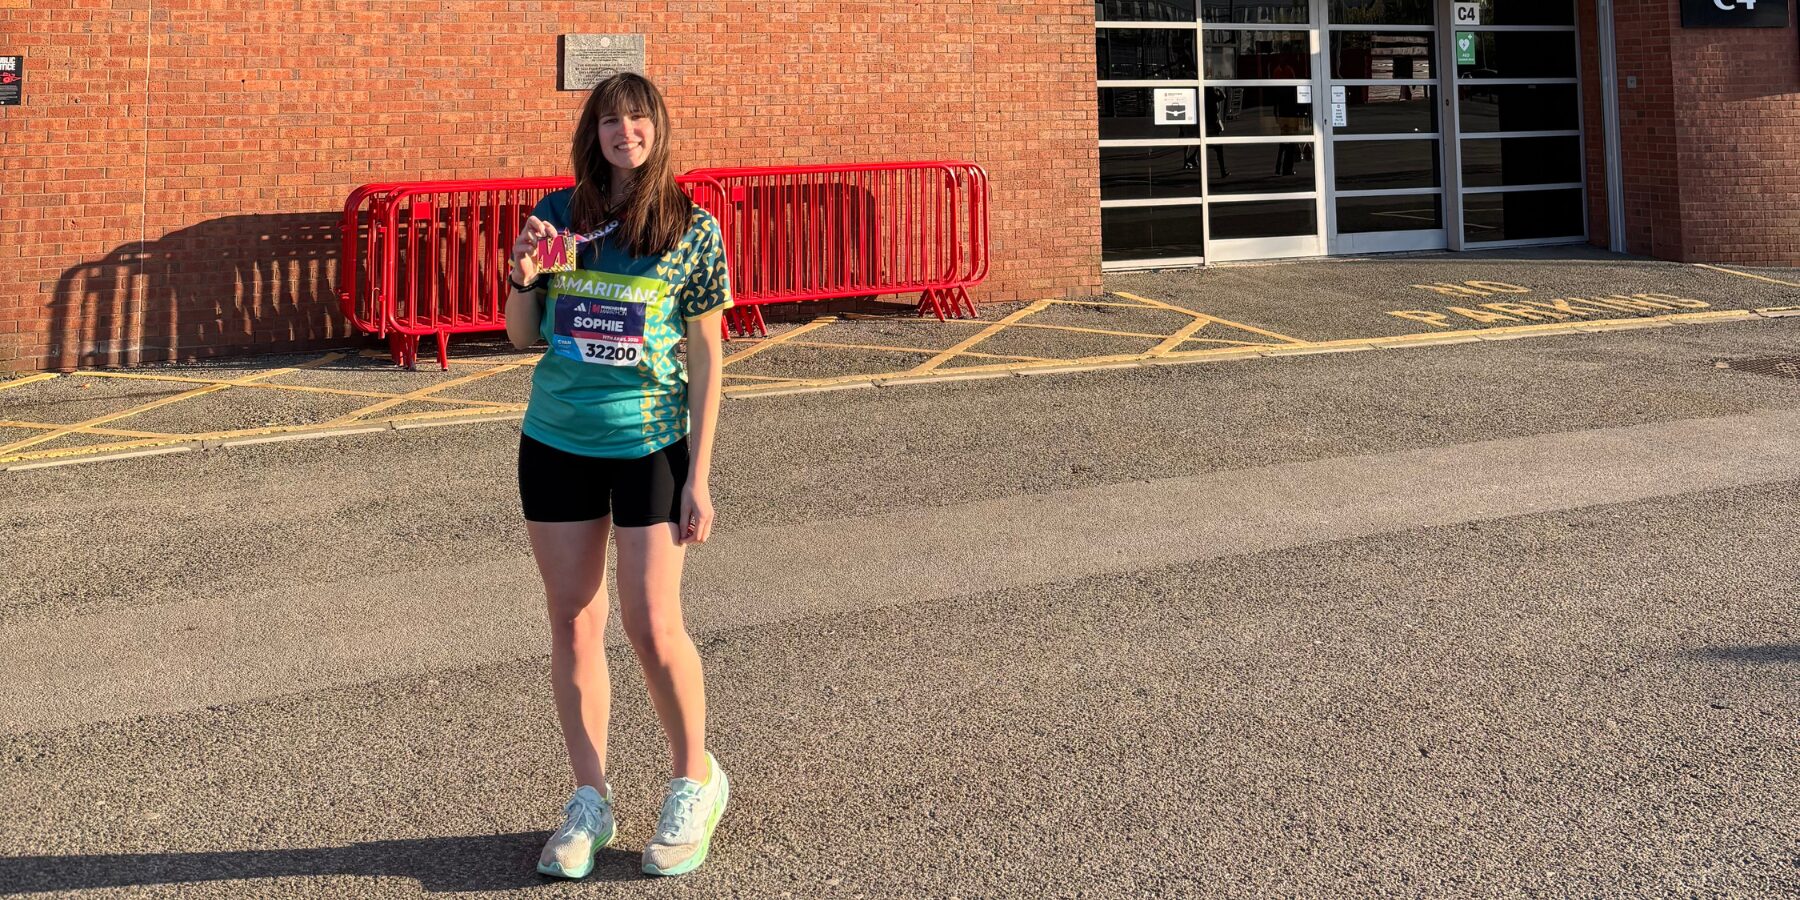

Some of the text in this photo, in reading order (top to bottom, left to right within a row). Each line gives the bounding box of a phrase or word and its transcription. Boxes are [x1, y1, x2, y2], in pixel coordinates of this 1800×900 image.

[1458, 6, 1475, 21] C4
[538, 235, 568, 269] M
[554, 275, 659, 306] SAMARITANS
[1409, 280, 1532, 298] NO
[1384, 293, 1711, 328] PARKING
[573, 316, 625, 332] SOPHIE
[585, 342, 637, 361] 32200
